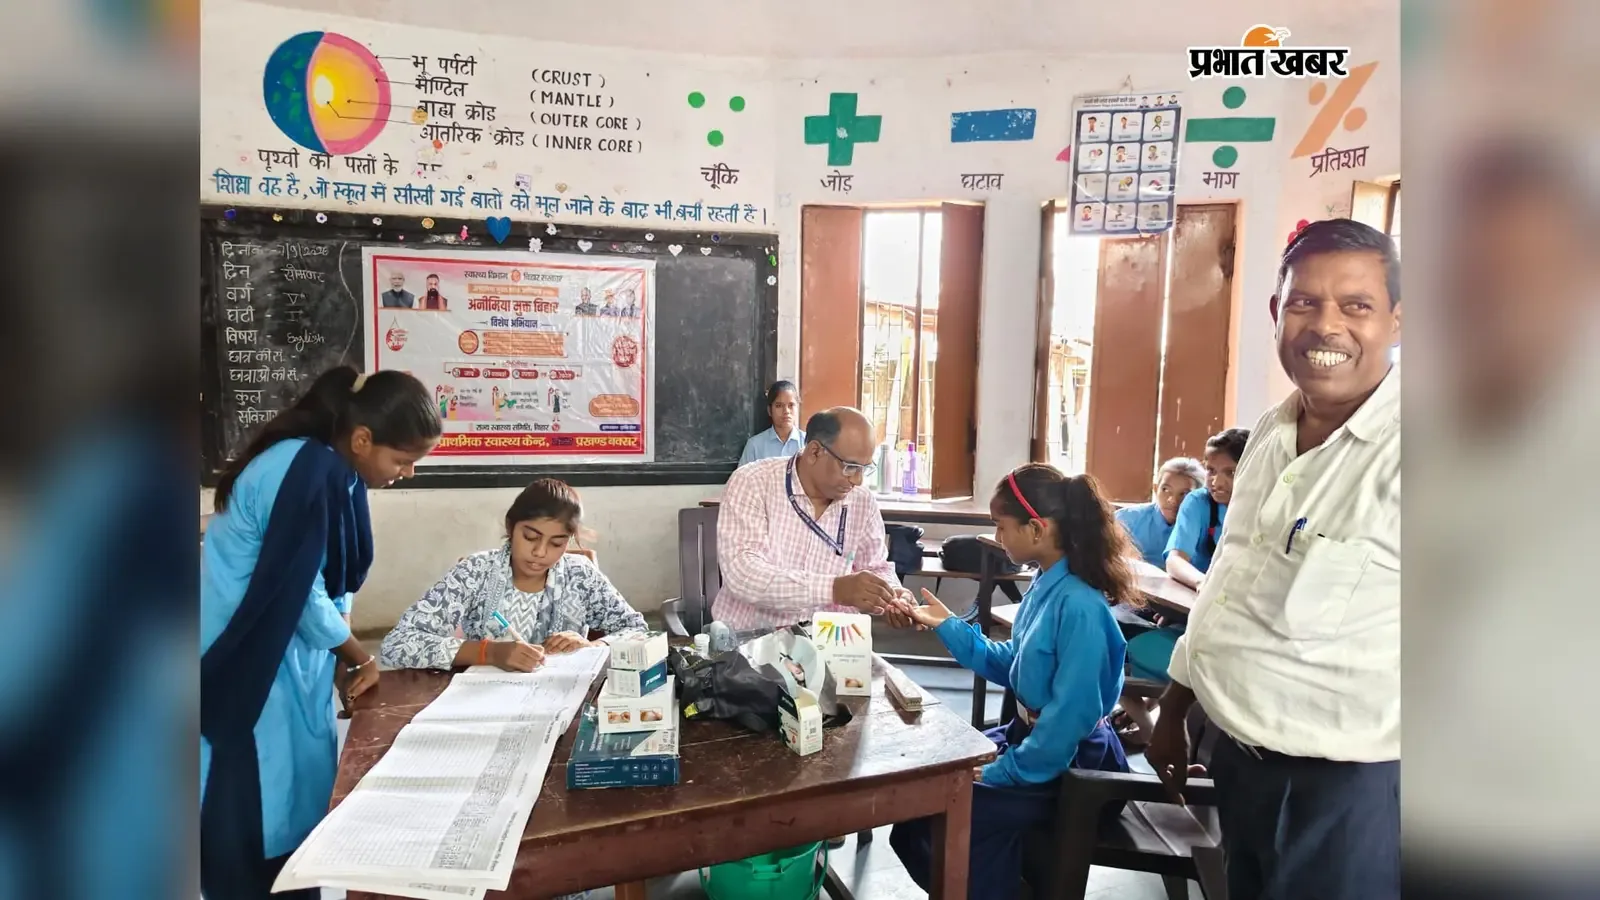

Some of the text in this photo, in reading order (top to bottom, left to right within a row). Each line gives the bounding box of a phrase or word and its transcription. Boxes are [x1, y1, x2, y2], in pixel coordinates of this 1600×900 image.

[437, 53, 478, 76] पर्पटी
[465, 100, 497, 122] क्रोड
[419, 121, 525, 147] आंतरिक क्रोड
[258, 148, 300, 172] पृथ्वी
[344, 154, 377, 174] परतों
[383, 153, 399, 175] के
[1309, 146, 1369, 178] प्रतिशत
[820, 170, 854, 194] जोड़
[961, 173, 1004, 190] घटाव
[1203, 171, 1240, 189] भाग
[212, 168, 252, 195] शिक्षा
[259, 177, 282, 197] वह
[309, 177, 330, 199] जो
[333, 182, 367, 205] स्कूल
[371, 182, 387, 202] में
[393, 183, 435, 206] सीखी
[440, 185, 465, 207] गई
[510, 189, 530, 210] को
[535, 195, 560, 218] भूल
[565, 195, 593, 216] जाने
[599, 196, 615, 216] के
[621, 201, 649, 219] बाद
[707, 203, 739, 223] रहती
[222, 261, 250, 279] दिन
[226, 283, 254, 302] वर्ग
[226, 305, 255, 323] घंटी
[468, 296, 510, 312] अनीमिया
[512, 299, 532, 316] मुक्त
[510, 317, 538, 329] अभियान
[225, 328, 325, 352] विषय English
[228, 350, 256, 363] छात्र
[255, 348, 271, 362] की
[271, 367, 285, 381] की
[233, 389, 266, 406] कुल
[438, 435, 482, 448] प्राथमिक
[484, 436, 520, 448] स्वास्थ्य
[575, 436, 607, 448] प्रखण्ड
